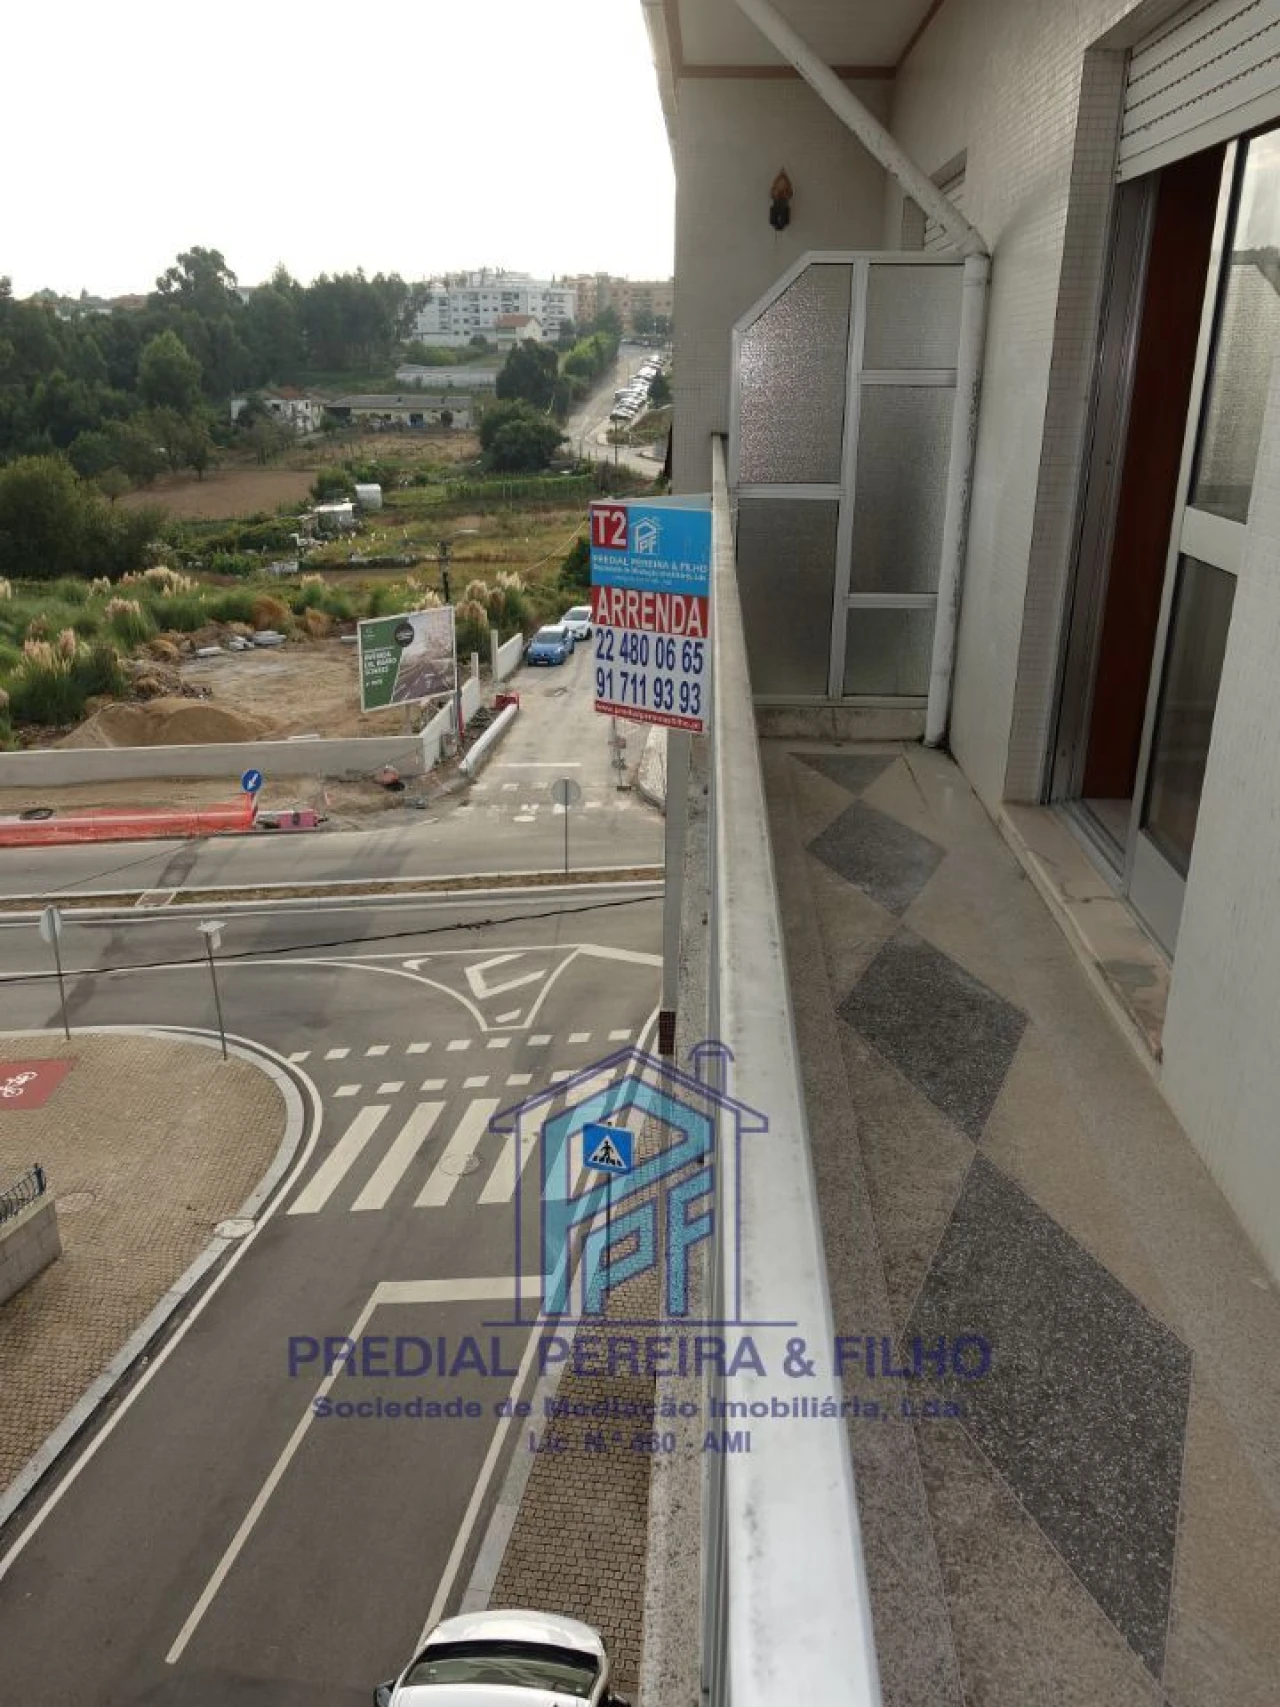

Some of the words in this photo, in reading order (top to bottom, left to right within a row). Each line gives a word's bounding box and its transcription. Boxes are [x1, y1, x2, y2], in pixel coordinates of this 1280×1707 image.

[593, 510, 626, 546] T2
[597, 587, 703, 636] ARRENDA
[596, 627, 614, 661] 22
[619, 632, 649, 667] 480
[655, 636, 676, 671] 06
[682, 640, 704, 675] 65
[596, 666, 613, 699] 91
[620, 671, 646, 706] 711
[653, 676, 674, 710] 93
[679, 680, 701, 715] 93
